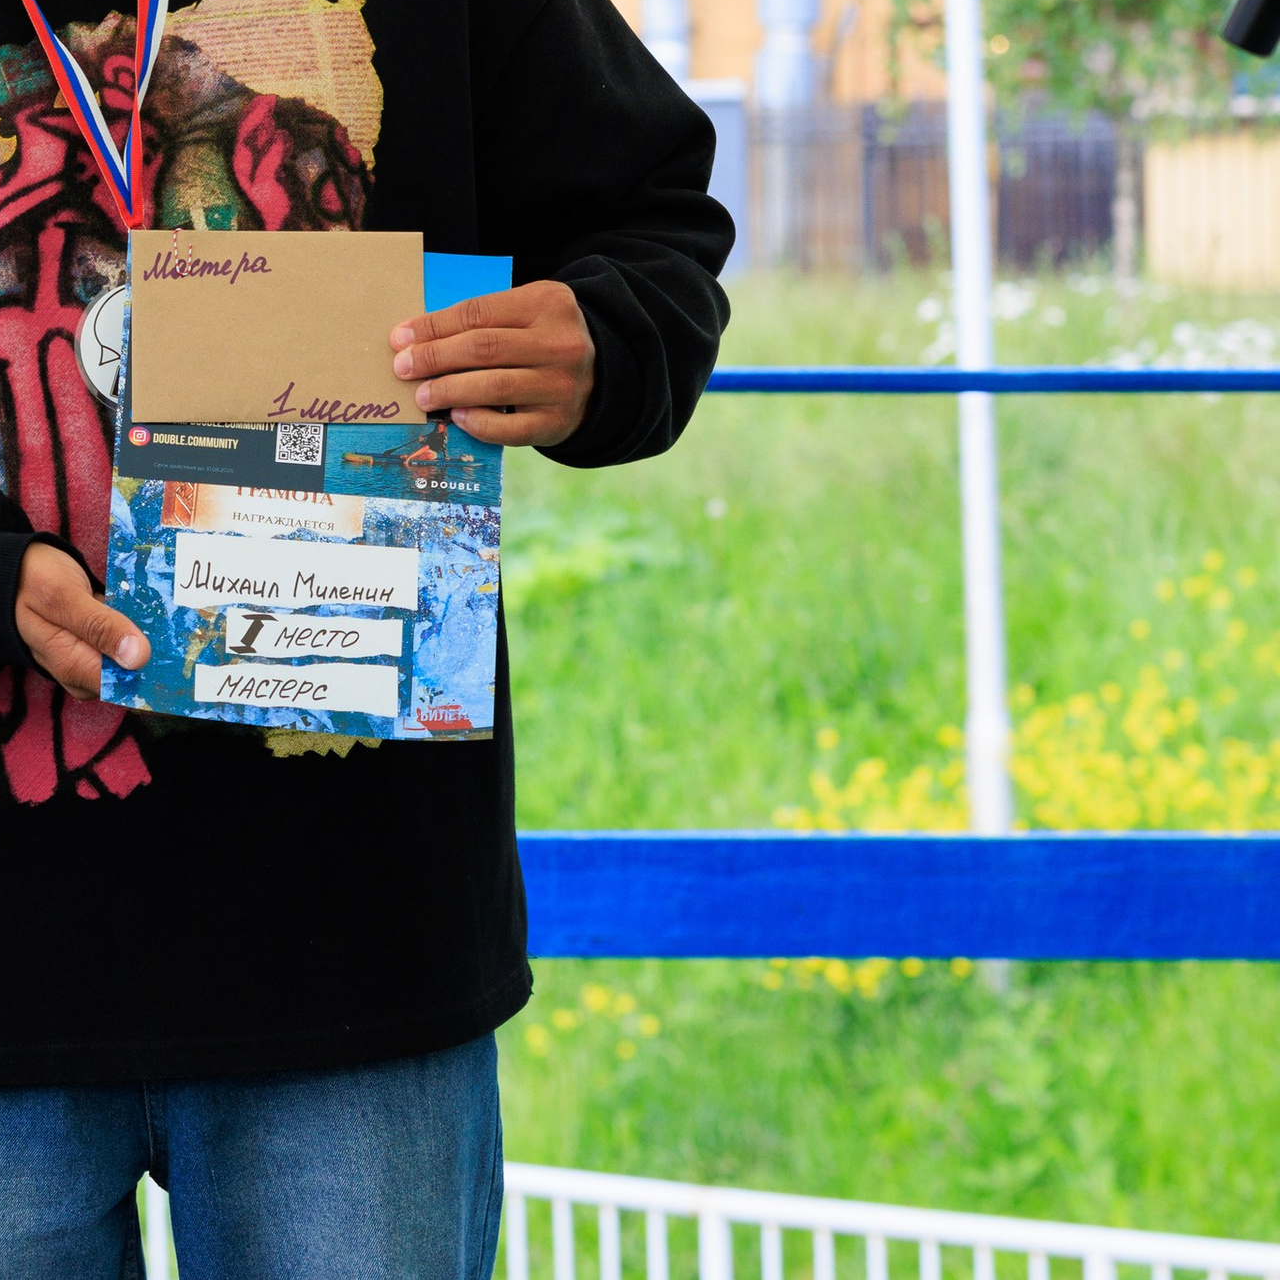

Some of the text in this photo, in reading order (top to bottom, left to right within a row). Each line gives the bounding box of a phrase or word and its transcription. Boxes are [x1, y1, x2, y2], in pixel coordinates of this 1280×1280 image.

[144, 251, 272, 284] Мастера
[267, 381, 400, 422] 1 место
[153, 433, 238, 449] DOUBLE.COMMUNITY
[431, 481, 480, 491] DOUBLE
[232, 512, 335, 531] НАГРАЖДАЕТСЯ
[180, 560, 279, 598] Михаил
